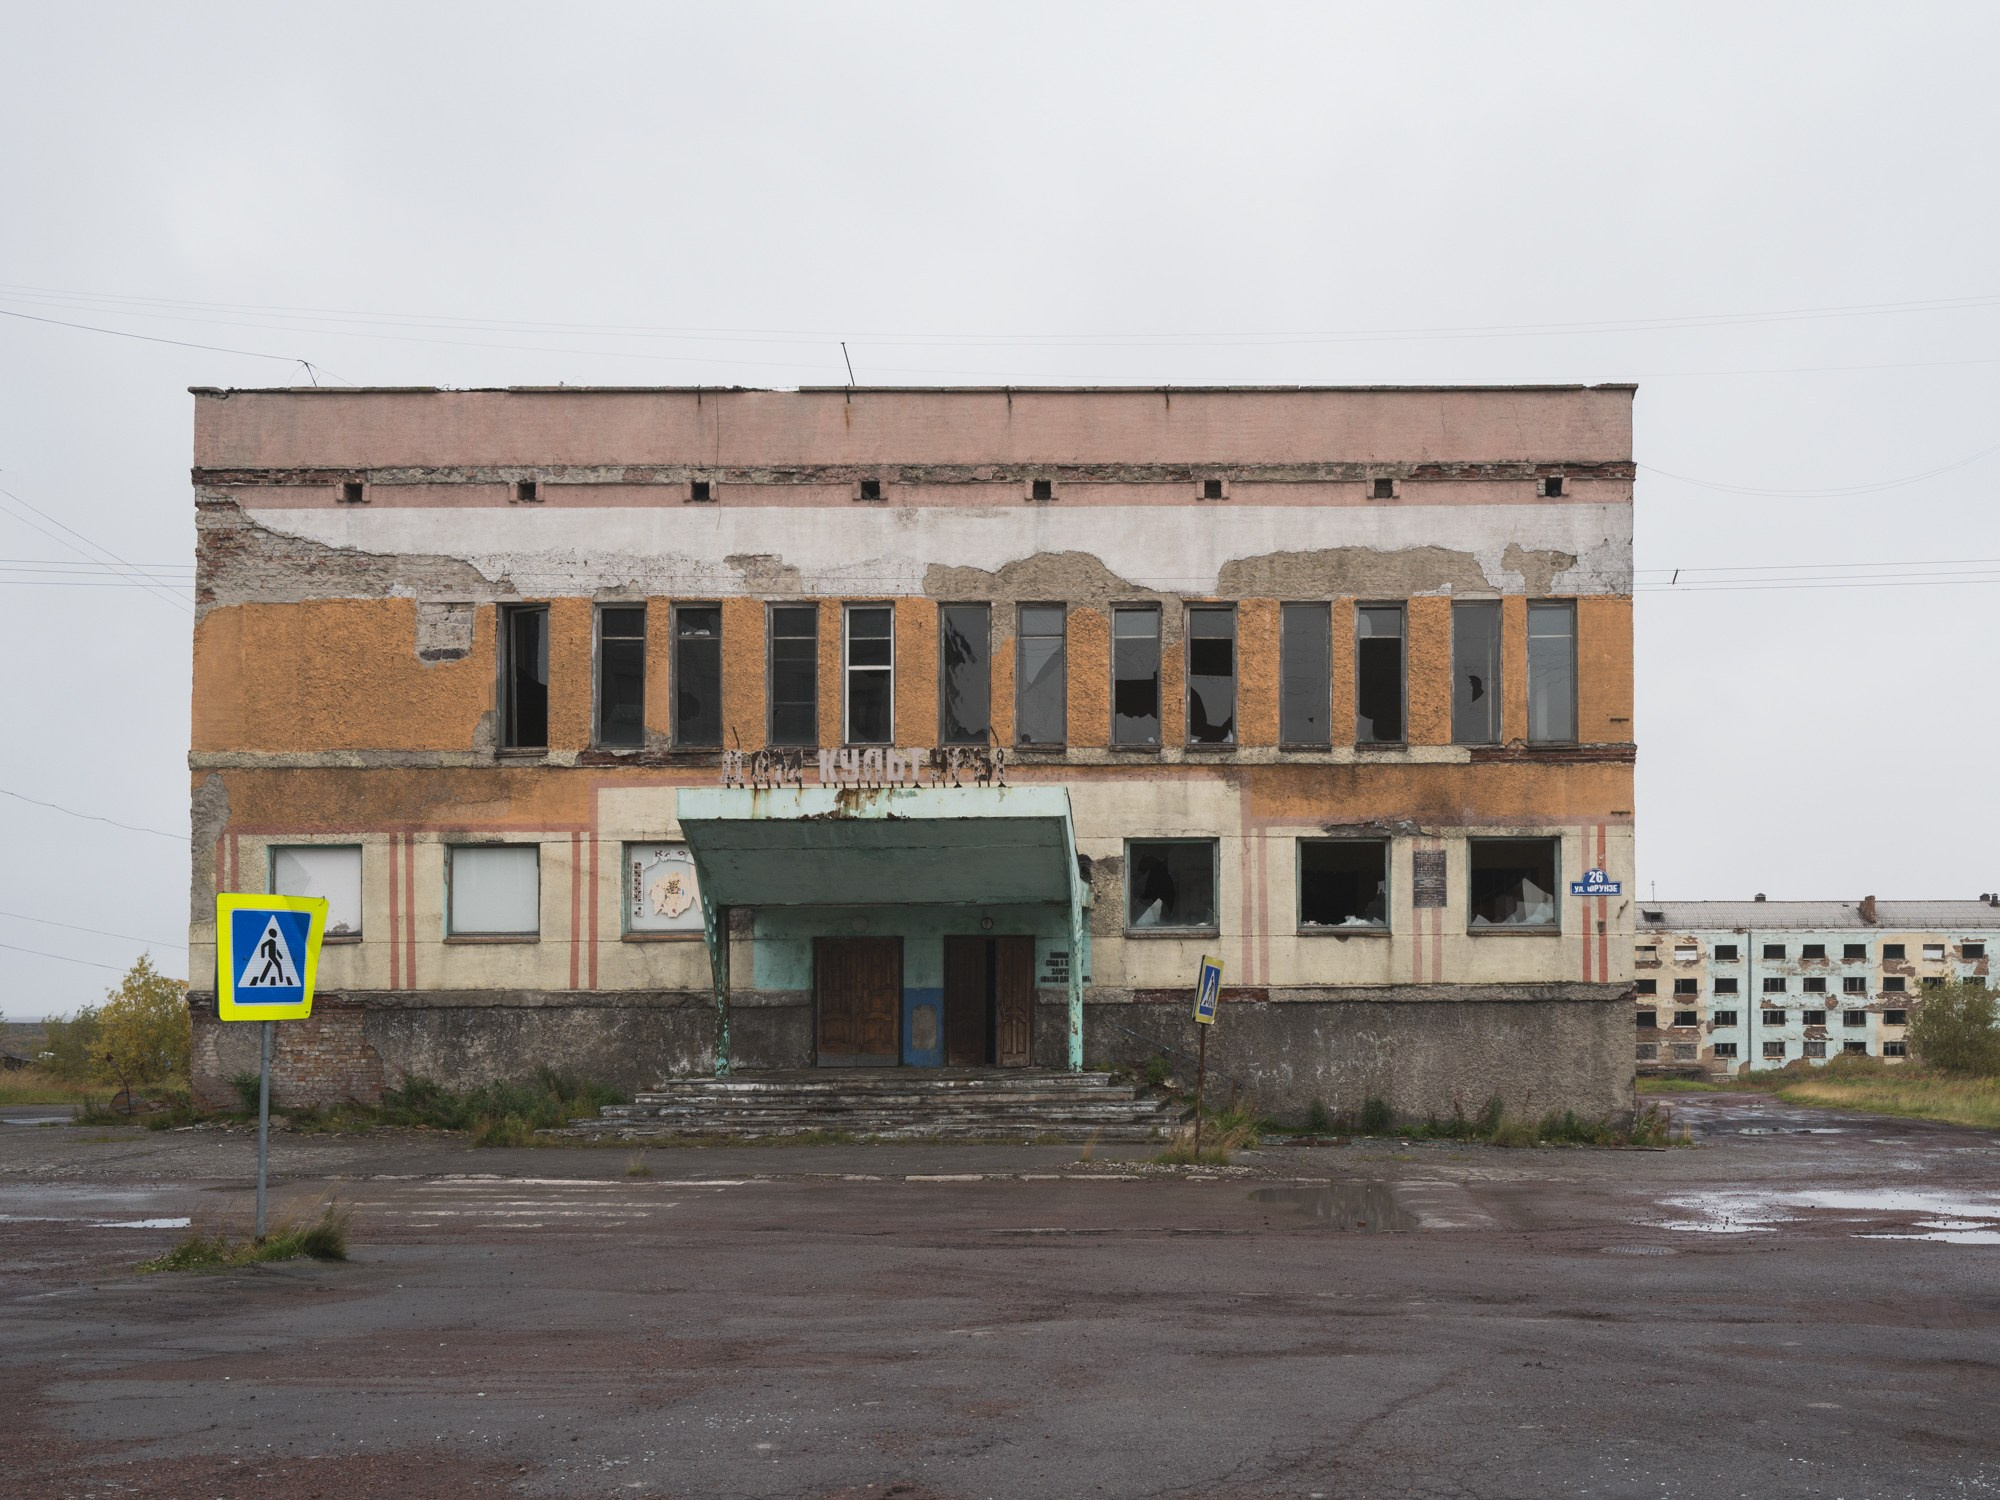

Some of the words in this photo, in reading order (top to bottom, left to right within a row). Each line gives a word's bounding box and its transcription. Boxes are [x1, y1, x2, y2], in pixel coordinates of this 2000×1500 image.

[721, 749, 803, 784] ДОМ
[818, 747, 1005, 782] КУЛЬТУРЫ
[1589, 871, 1603, 883] 26
